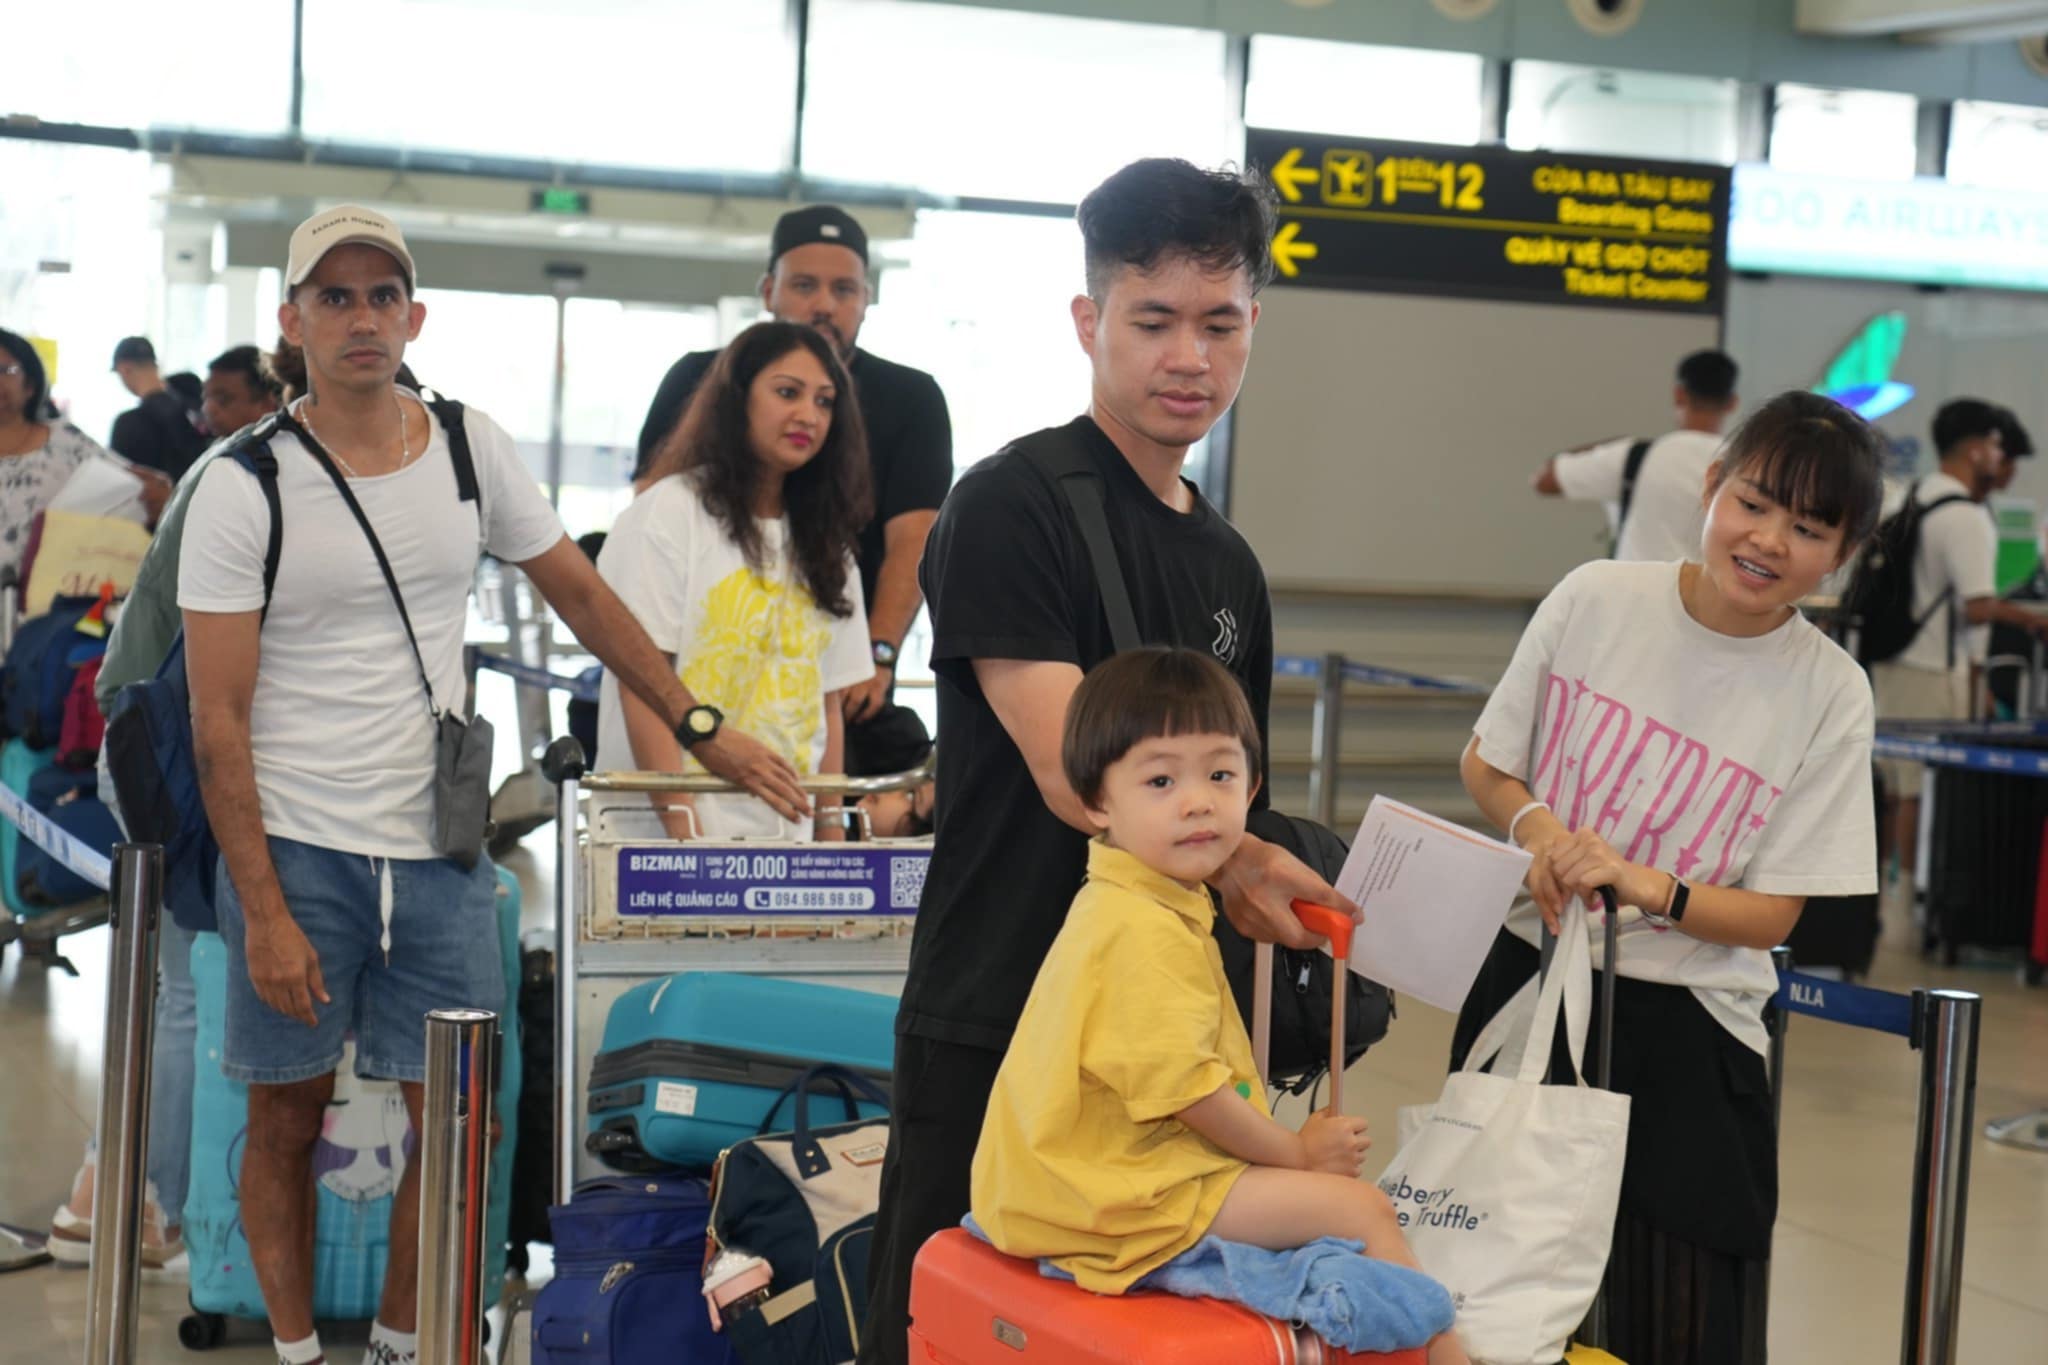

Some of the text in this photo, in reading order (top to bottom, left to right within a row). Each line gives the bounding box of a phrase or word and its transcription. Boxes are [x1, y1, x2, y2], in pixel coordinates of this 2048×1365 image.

[1376, 156, 1397, 205] 1
[1435, 162, 1485, 211] 12
[1586, 170, 1620, 196] RA
[1669, 177, 1713, 202] BAY
[1558, 197, 1713, 235] Boarding Gates
[1564, 267, 1709, 302] Ticket Counter
[630, 855, 697, 871] BIZMAN
[725, 855, 787, 879] 20.000
[630, 890, 655, 907] LIÊN
[658, 890, 672, 909] HỆ
[675, 889, 713, 907] QUẢNG
[715, 890, 738, 907] CÁO
